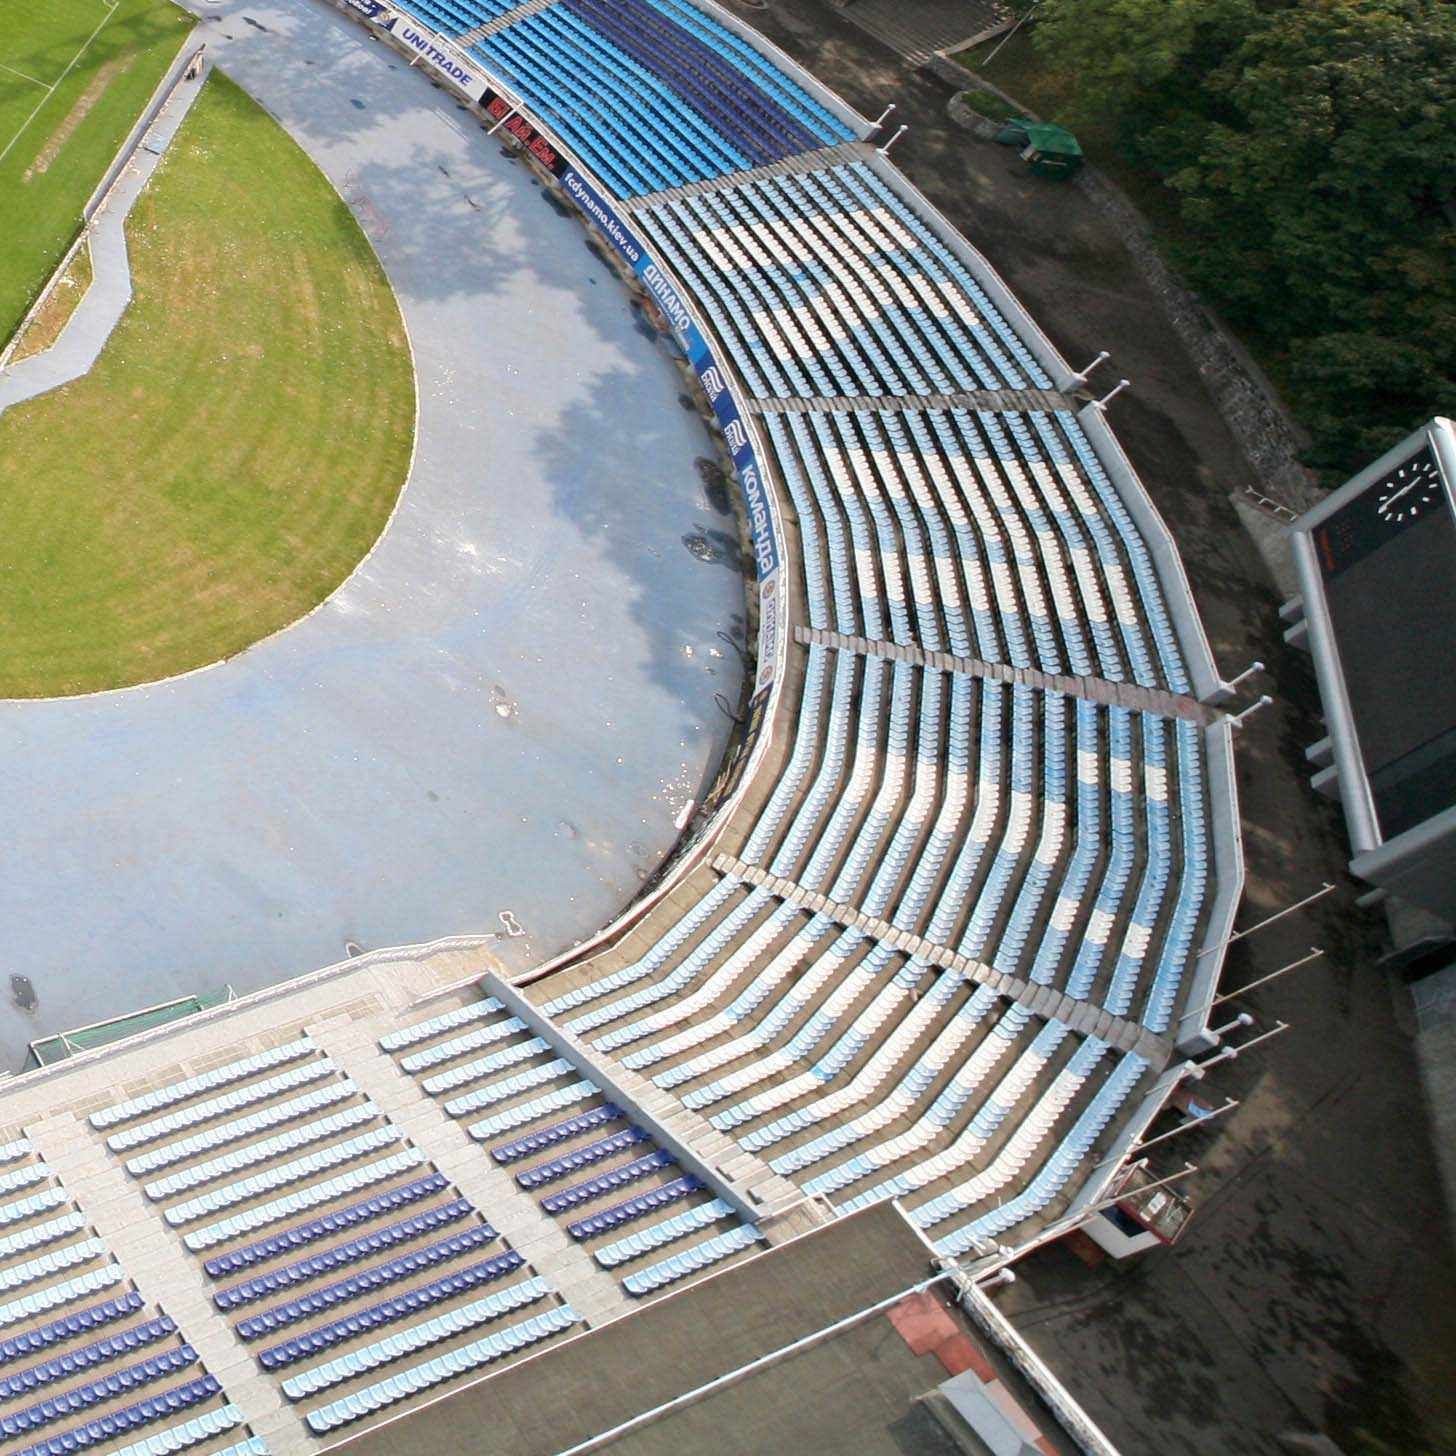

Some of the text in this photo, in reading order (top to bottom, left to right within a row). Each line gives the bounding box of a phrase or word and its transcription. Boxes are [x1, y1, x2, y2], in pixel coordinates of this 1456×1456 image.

[402, 27, 473, 86] UNITRADE
[564, 171, 640, 263] fcdynamo.kiev.ua
[642, 264, 691, 329] ДИНАМО
